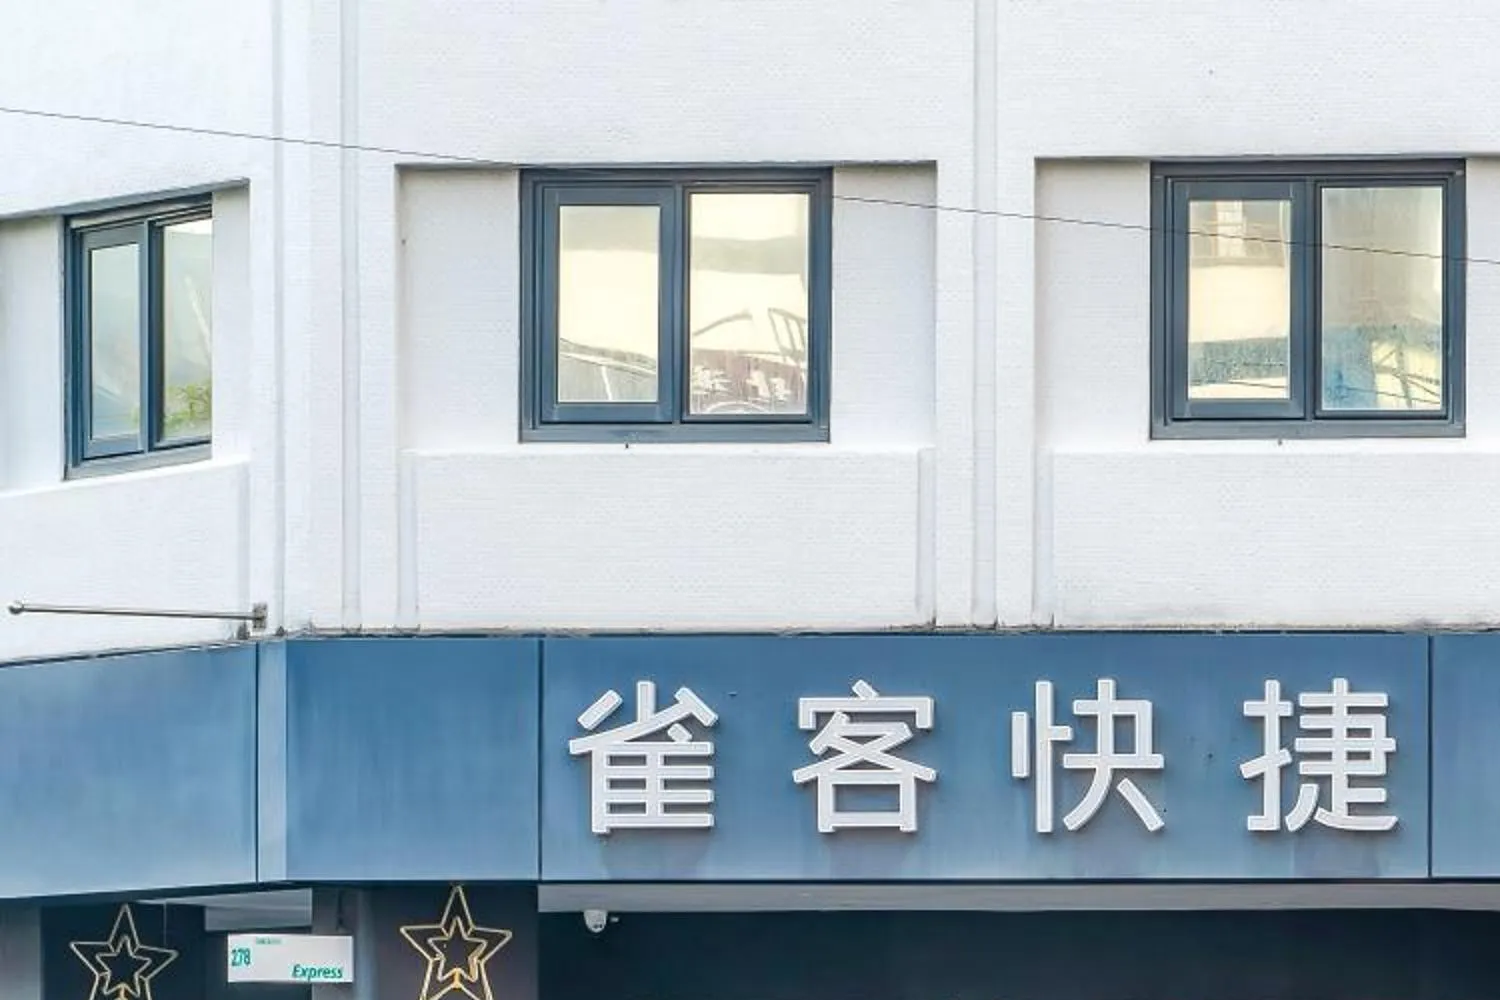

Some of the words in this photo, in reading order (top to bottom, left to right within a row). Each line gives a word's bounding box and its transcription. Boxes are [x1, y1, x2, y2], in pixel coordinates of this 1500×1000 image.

[569, 678, 1397, 833] 雀客快捷
[292, 964, 343, 981] Express
